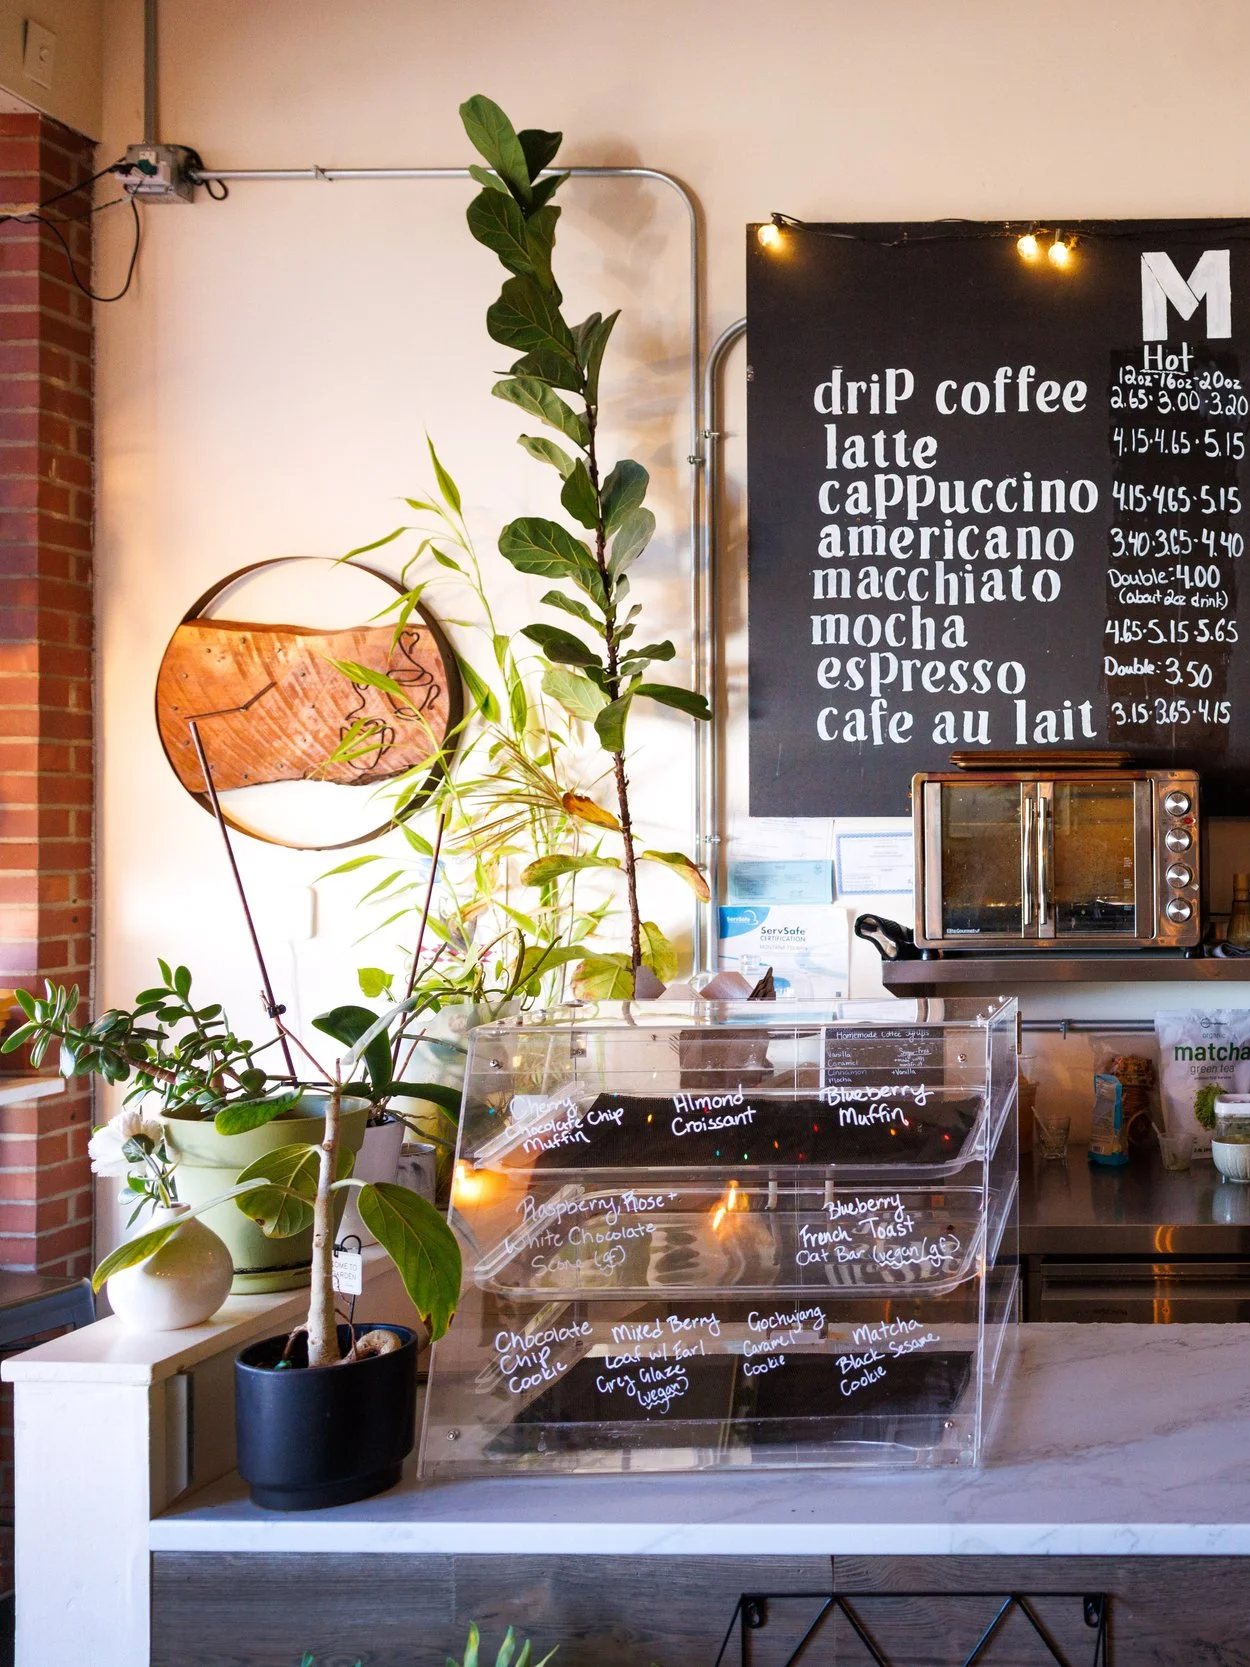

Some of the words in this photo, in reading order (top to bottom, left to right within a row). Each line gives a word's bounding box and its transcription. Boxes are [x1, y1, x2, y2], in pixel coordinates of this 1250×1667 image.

[1143, 342, 1194, 372] Hot
[936, 365, 1088, 415] coffee
[824, 424, 938, 469] latte
[818, 472, 1099, 520] cappuccino
[817, 519, 1075, 561] americano
[812, 561, 1061, 605] macchiato
[1119, 590, 1161, 605] (about
[1190, 591, 1228, 610] drink)
[810, 605, 968, 650] mocha
[817, 652, 1026, 697] espresso
[1165, 658, 1212, 688] 3.50
[817, 699, 914, 745] cafe
[932, 711, 991, 744] au
[1014, 700, 1097, 744] lait
[761, 926, 806, 935] ServSafe
[1190, 1064, 1218, 1075] green
[1220, 1064, 1235, 1073] tea
[510, 1096, 578, 1119] Cherry
[672, 1084, 744, 1114] Almond
[819, 1083, 935, 1106] Blueberry
[505, 1117, 584, 1140] Chocolate
[587, 1108, 625, 1126] Chip
[671, 1107, 757, 1136] Croissant
[839, 1104, 909, 1127] Muffin
[523, 1131, 591, 1154] Muffin
[621, 1190, 665, 1213] Rose
[822, 1194, 905, 1222] Blueberry
[505, 1229, 563, 1253] White
[568, 1223, 656, 1246] Chocolate
[800, 1224, 852, 1248] French
[859, 1215, 914, 1239] Toast
[532, 1255, 584, 1277] Scone
[796, 1249, 828, 1266] Oat
[834, 1245, 865, 1263] Bar
[611, 1318, 663, 1343] Mixed
[666, 1312, 720, 1337] Berry
[748, 1306, 826, 1333] Gochujang
[852, 1316, 923, 1345] Matcha
[495, 1321, 593, 1353] Chocolate
[743, 1331, 795, 1357] Caramel
[500, 1346, 551, 1375] Chip
[604, 1344, 641, 1370] Loaf
[743, 1354, 785, 1377] Cookie
[835, 1351, 886, 1374] Black
[888, 1332, 940, 1359] Sesame
[509, 1362, 568, 1394] Cookie
[596, 1374, 636, 1397] Grey
[639, 1363, 686, 1384] Glaze
[840, 1365, 887, 1396] Cookie
[637, 1376, 689, 1414] (vegan)
